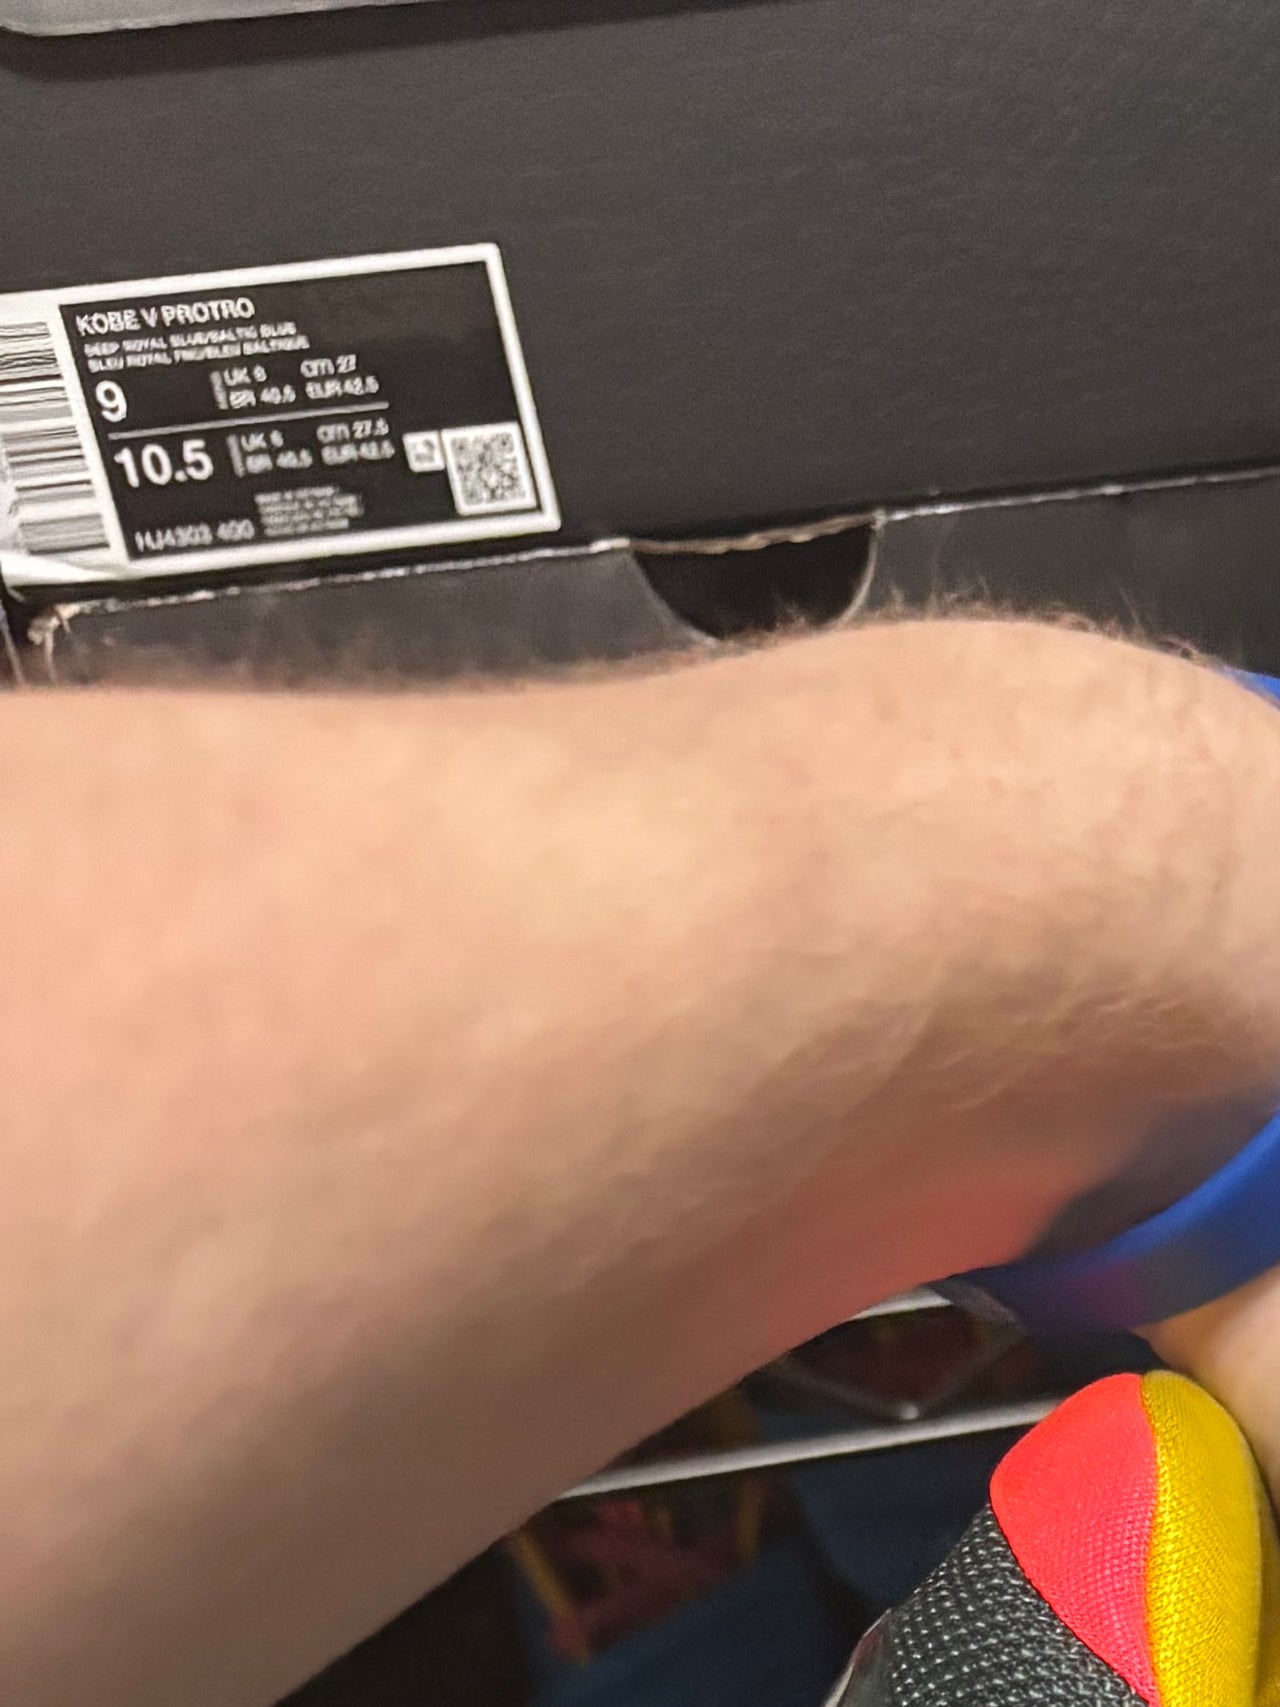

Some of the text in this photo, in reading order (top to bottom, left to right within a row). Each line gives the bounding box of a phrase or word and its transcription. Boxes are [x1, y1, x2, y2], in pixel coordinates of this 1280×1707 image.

[76, 297, 255, 336] KOBE V PROTRO
[223, 366, 251, 387] UK
[95, 380, 128, 422] 9
[114, 439, 214, 489] 10.5
